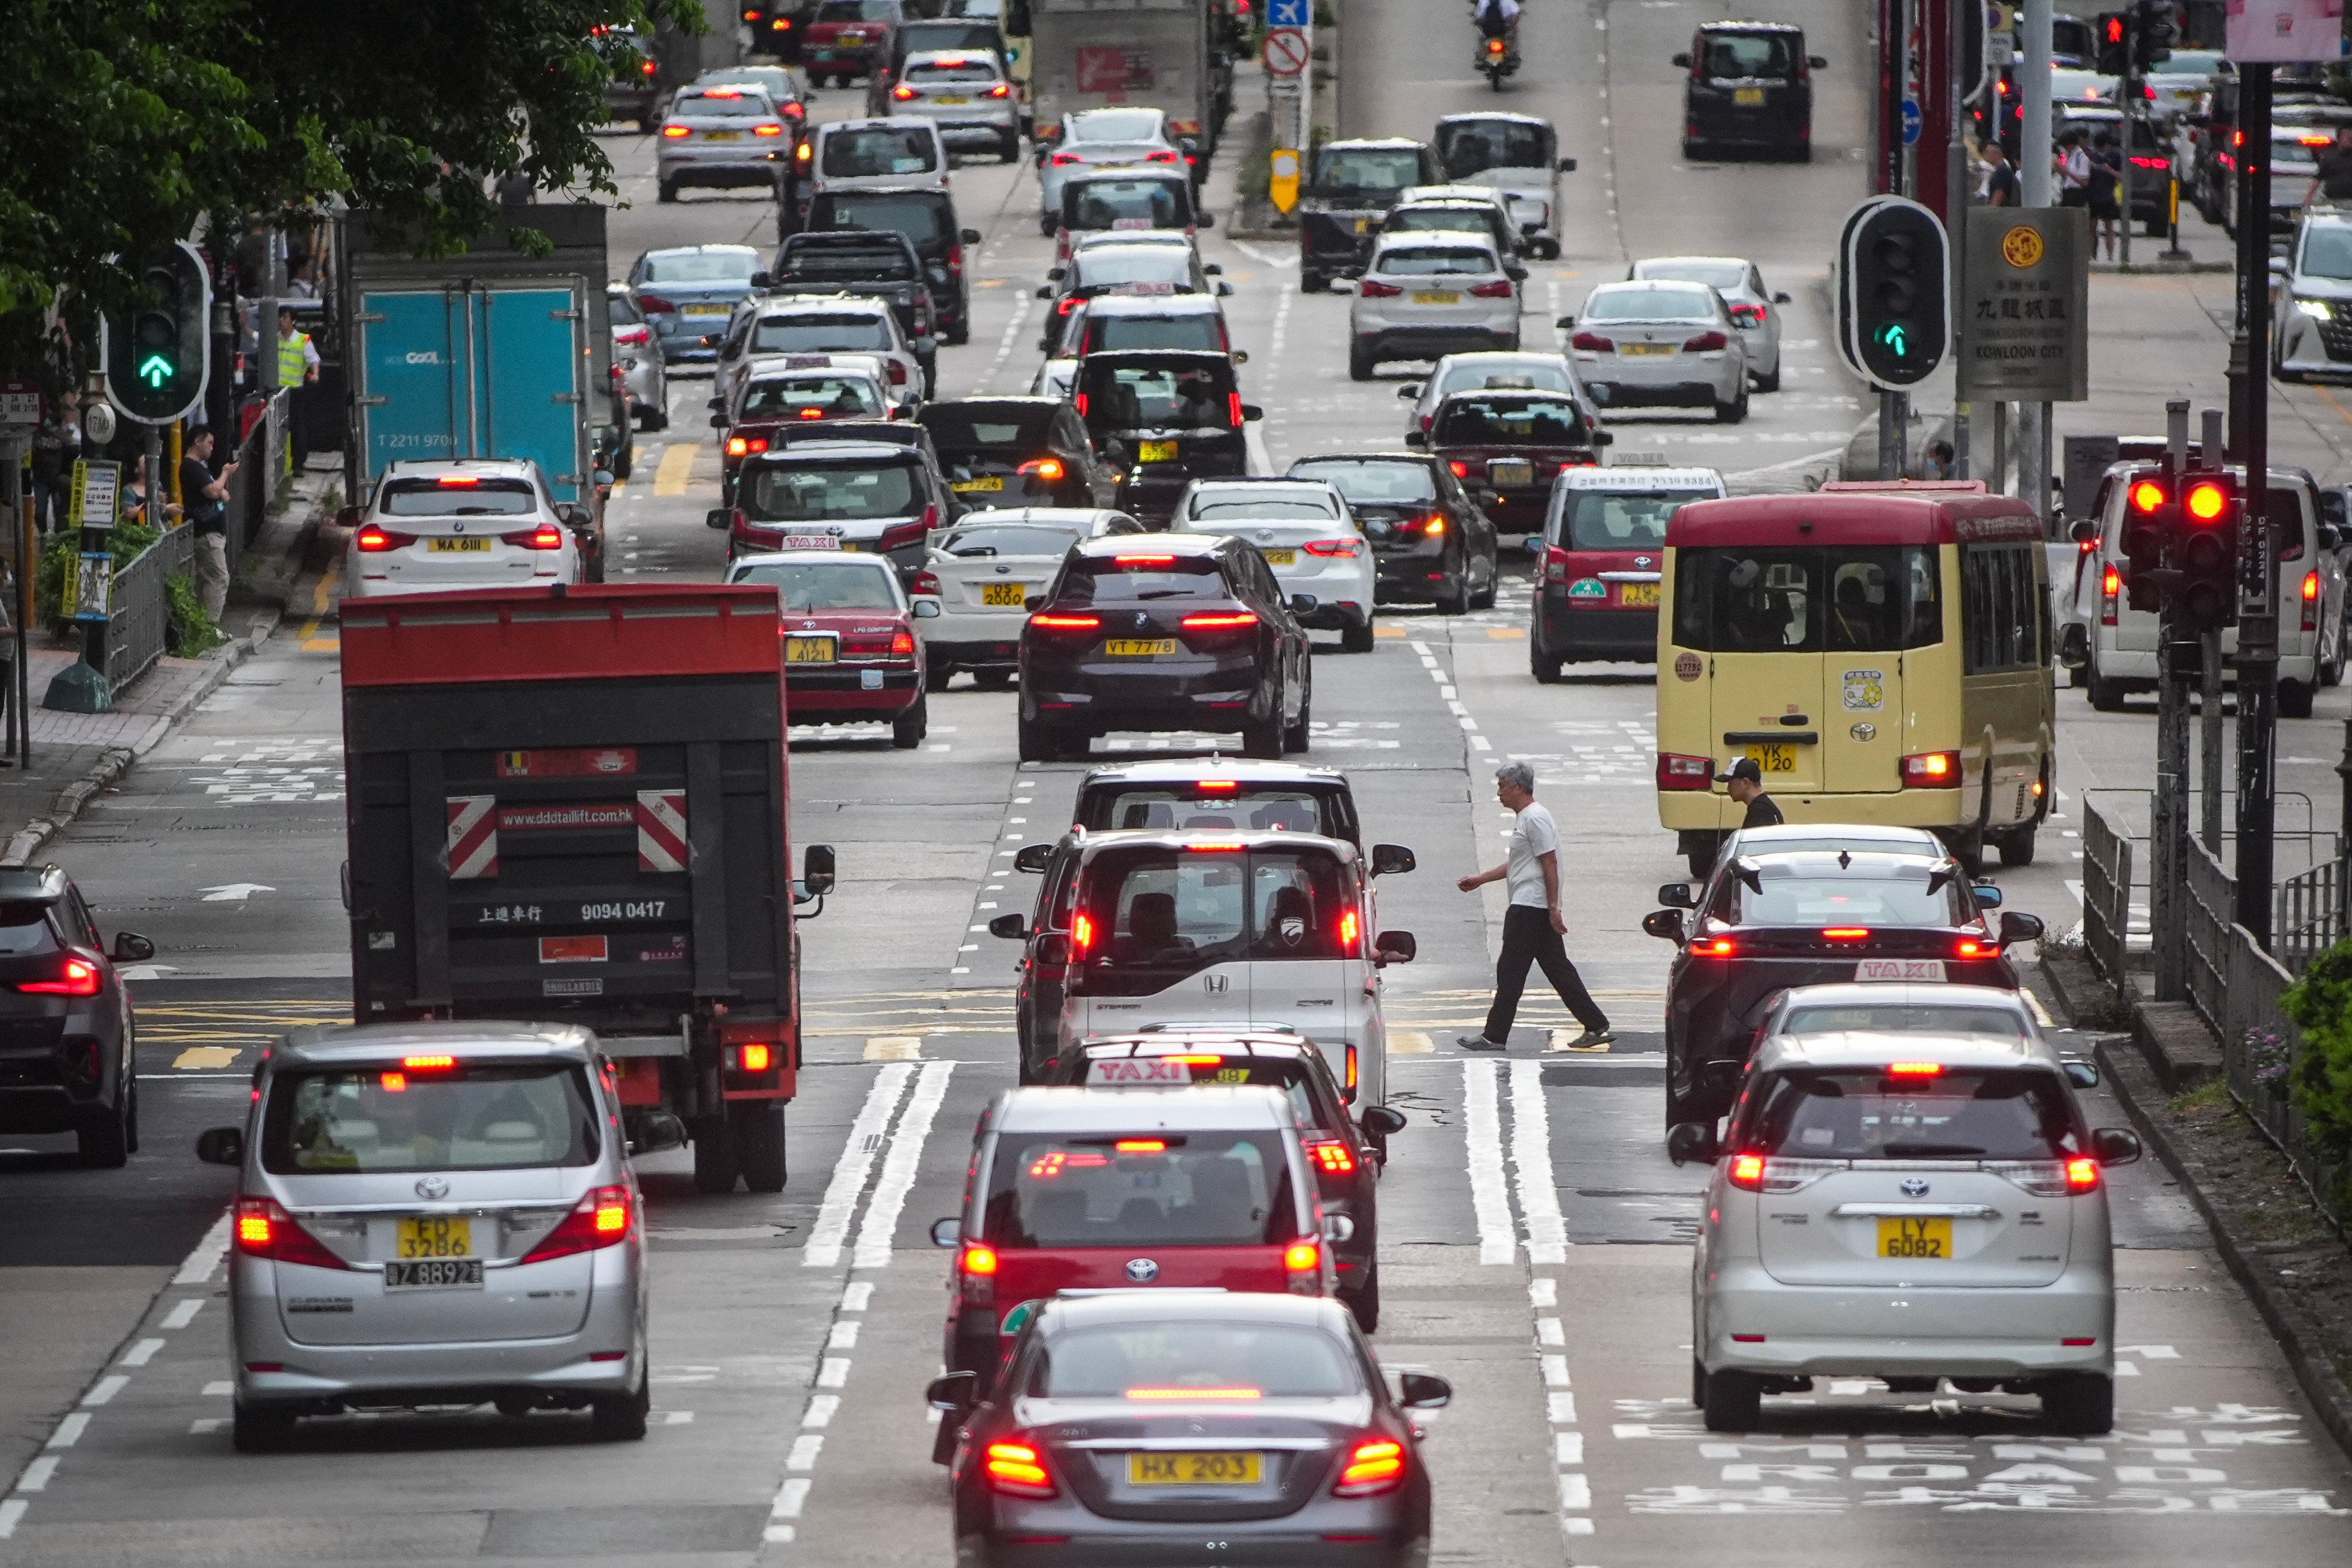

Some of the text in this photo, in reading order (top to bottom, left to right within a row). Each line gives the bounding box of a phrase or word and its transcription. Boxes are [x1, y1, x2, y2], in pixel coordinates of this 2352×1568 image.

[1976, 345, 2036, 359] KOWLOON
[377, 435, 386, 447] T
[389, 434, 420, 448] 2211
[787, 536, 836, 549] TAXI
[986, 593, 1022, 605] 2000
[797, 649, 825, 661] 4121
[1108, 640, 1172, 653] VT 7778
[1762, 745, 1780, 758] VK
[581, 901, 665, 921] 9094 0417
[1864, 962, 1939, 979] TAXI
[1098, 1063, 1181, 1080] TAXI
[1901, 1219, 1928, 1239] LY
[404, 1238, 467, 1257] 3286
[1887, 1238, 1942, 1258] 6082
[1611, 1424, 2306, 1445] ENK
[1696, 1442, 2236, 1463] MENT
[1140, 1455, 1247, 1482] HX 203
[1719, 1463, 2229, 1483] ROAD
